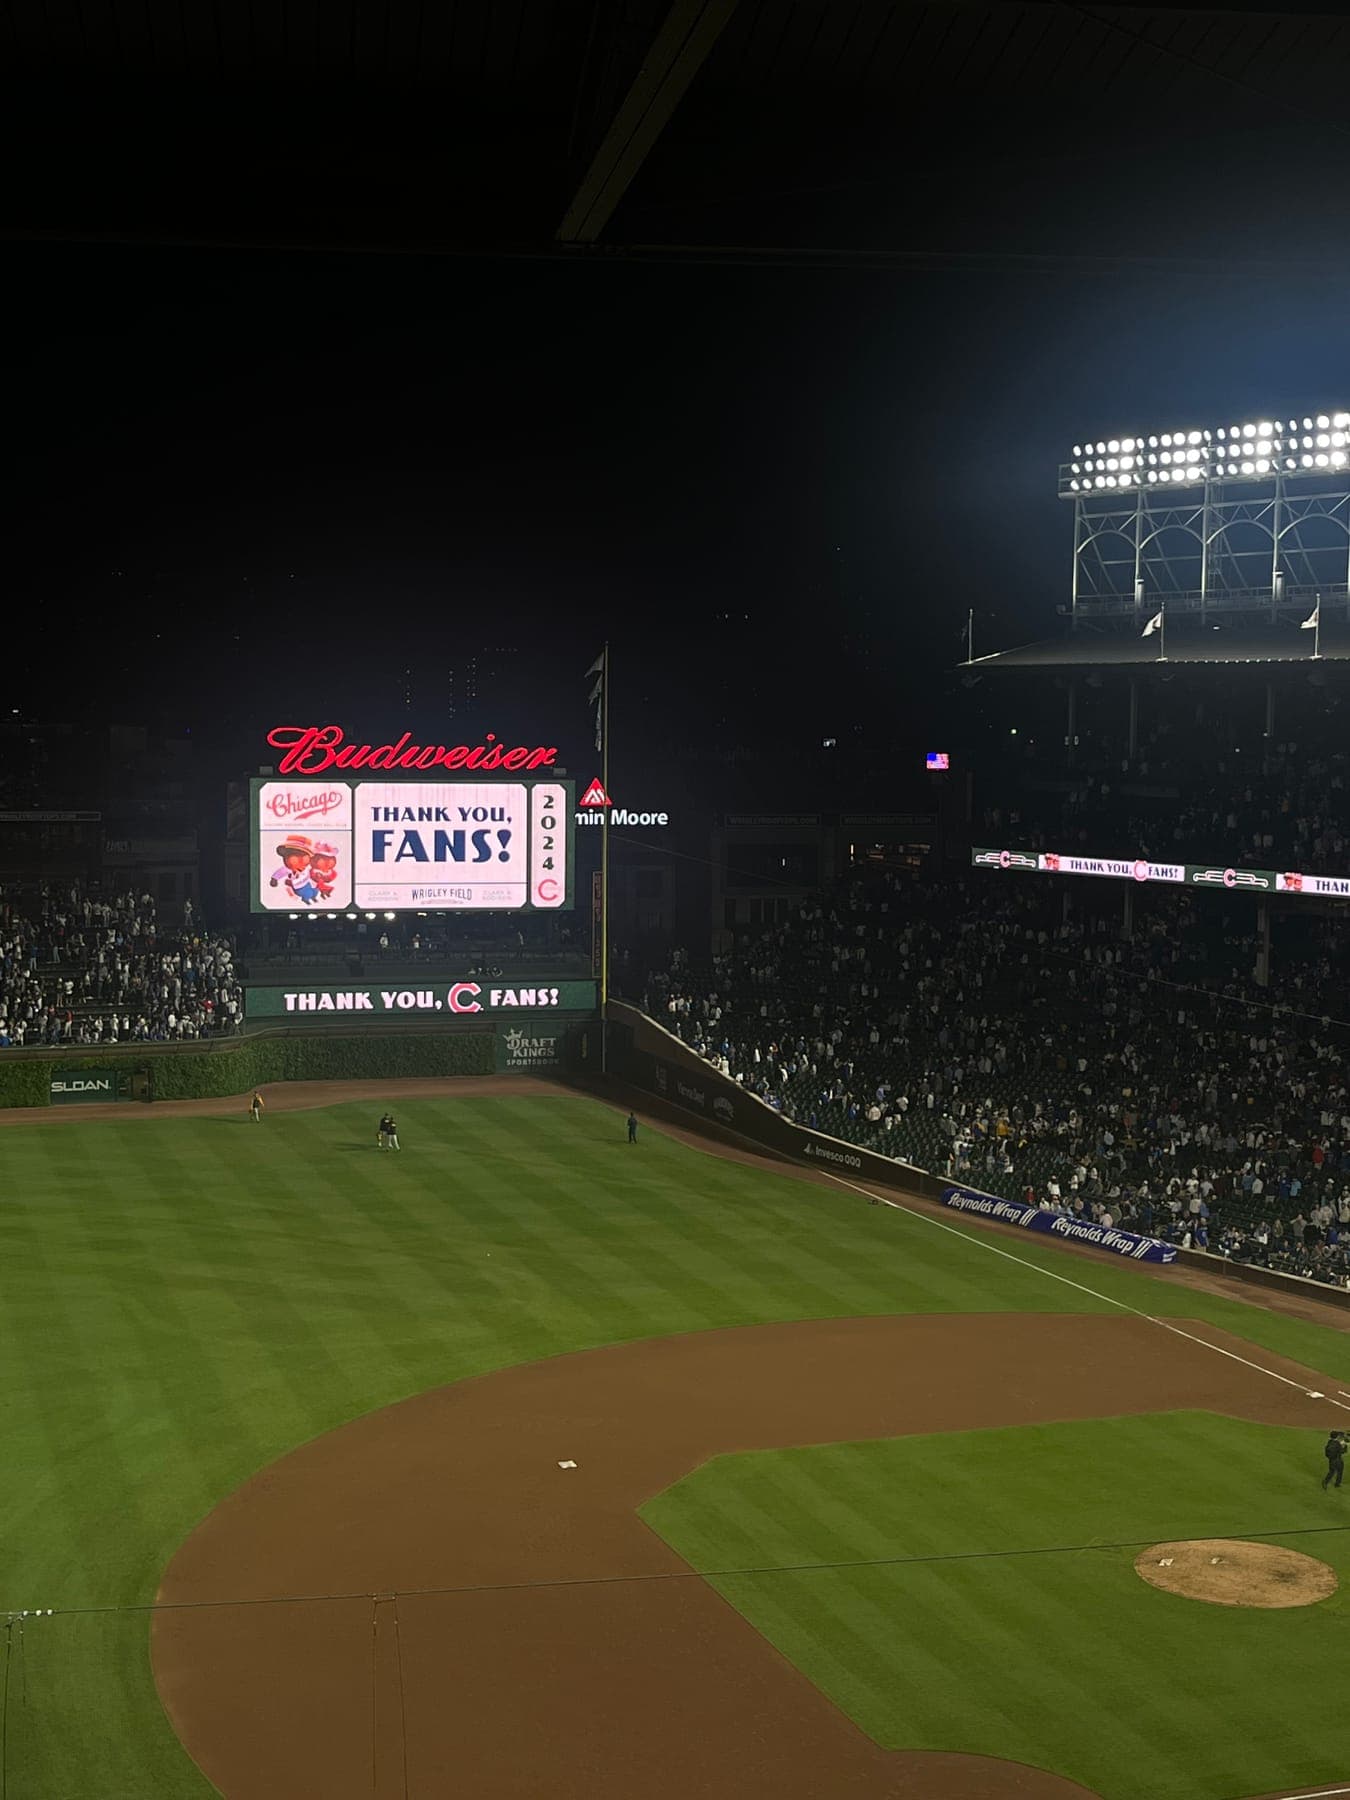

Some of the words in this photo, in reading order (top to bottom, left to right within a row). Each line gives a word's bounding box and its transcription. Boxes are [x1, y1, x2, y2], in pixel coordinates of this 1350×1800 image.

[267, 726, 557, 774] Budweiser
[266, 791, 342, 820] Chicago
[371, 807, 450, 822] THANK
[458, 807, 512, 824] YOU,
[611, 809, 668, 825] Moore
[372, 829, 512, 862] FANS!
[1070, 860, 1104, 872] THANK
[1148, 866, 1179, 878] FANS!
[412, 888, 447, 901] WRIGLEY
[450, 888, 472, 901] FIELD
[284, 992, 373, 1011] THANK
[381, 991, 442, 1010] YOU,
[490, 988, 559, 1007] FANS!
[507, 1037, 556, 1050] DRAFT
[513, 1048, 555, 1057] KINGS
[51, 1080, 109, 1092] SLOAN
[947, 1192, 993, 1214] Reynolds
[992, 1201, 1021, 1222] Wrap
[1051, 1217, 1103, 1242] Reynolds
[1101, 1231, 1134, 1253] Wrap
